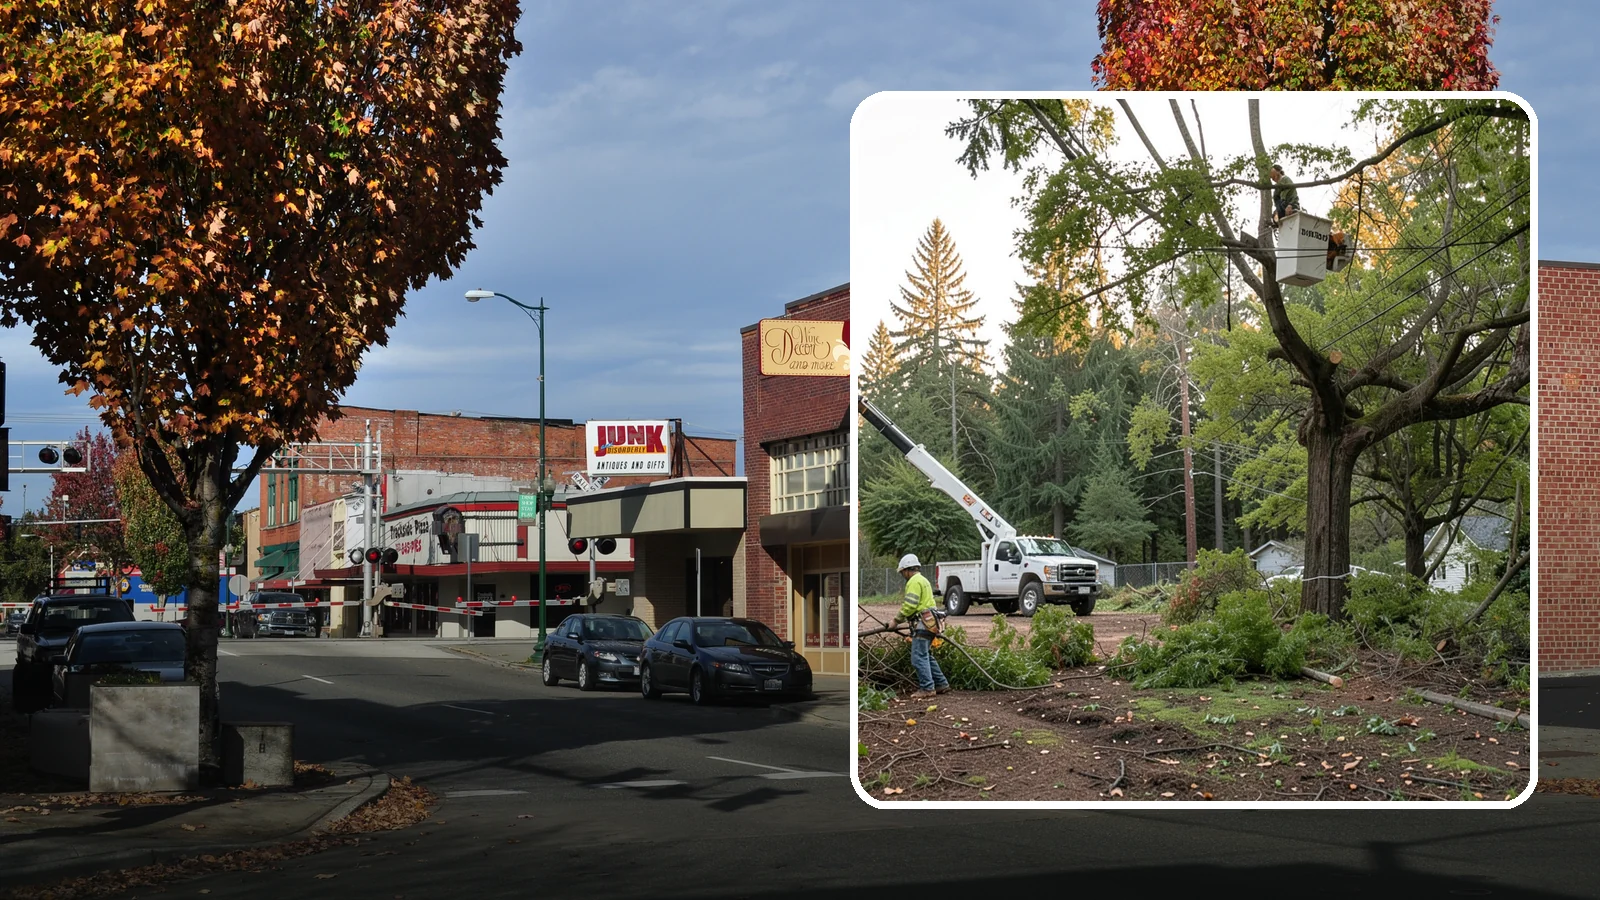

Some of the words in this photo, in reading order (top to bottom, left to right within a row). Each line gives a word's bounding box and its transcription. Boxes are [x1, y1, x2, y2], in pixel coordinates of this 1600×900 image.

[595, 425, 665, 457] JUNK
[597, 461, 628, 470] ANTIQUES
[631, 461, 643, 470] AND
[647, 461, 665, 470] GIFTS
[573, 473, 589, 492] RAIL
[390, 521, 413, 540] Trackside
[415, 519, 429, 534] Pizza
